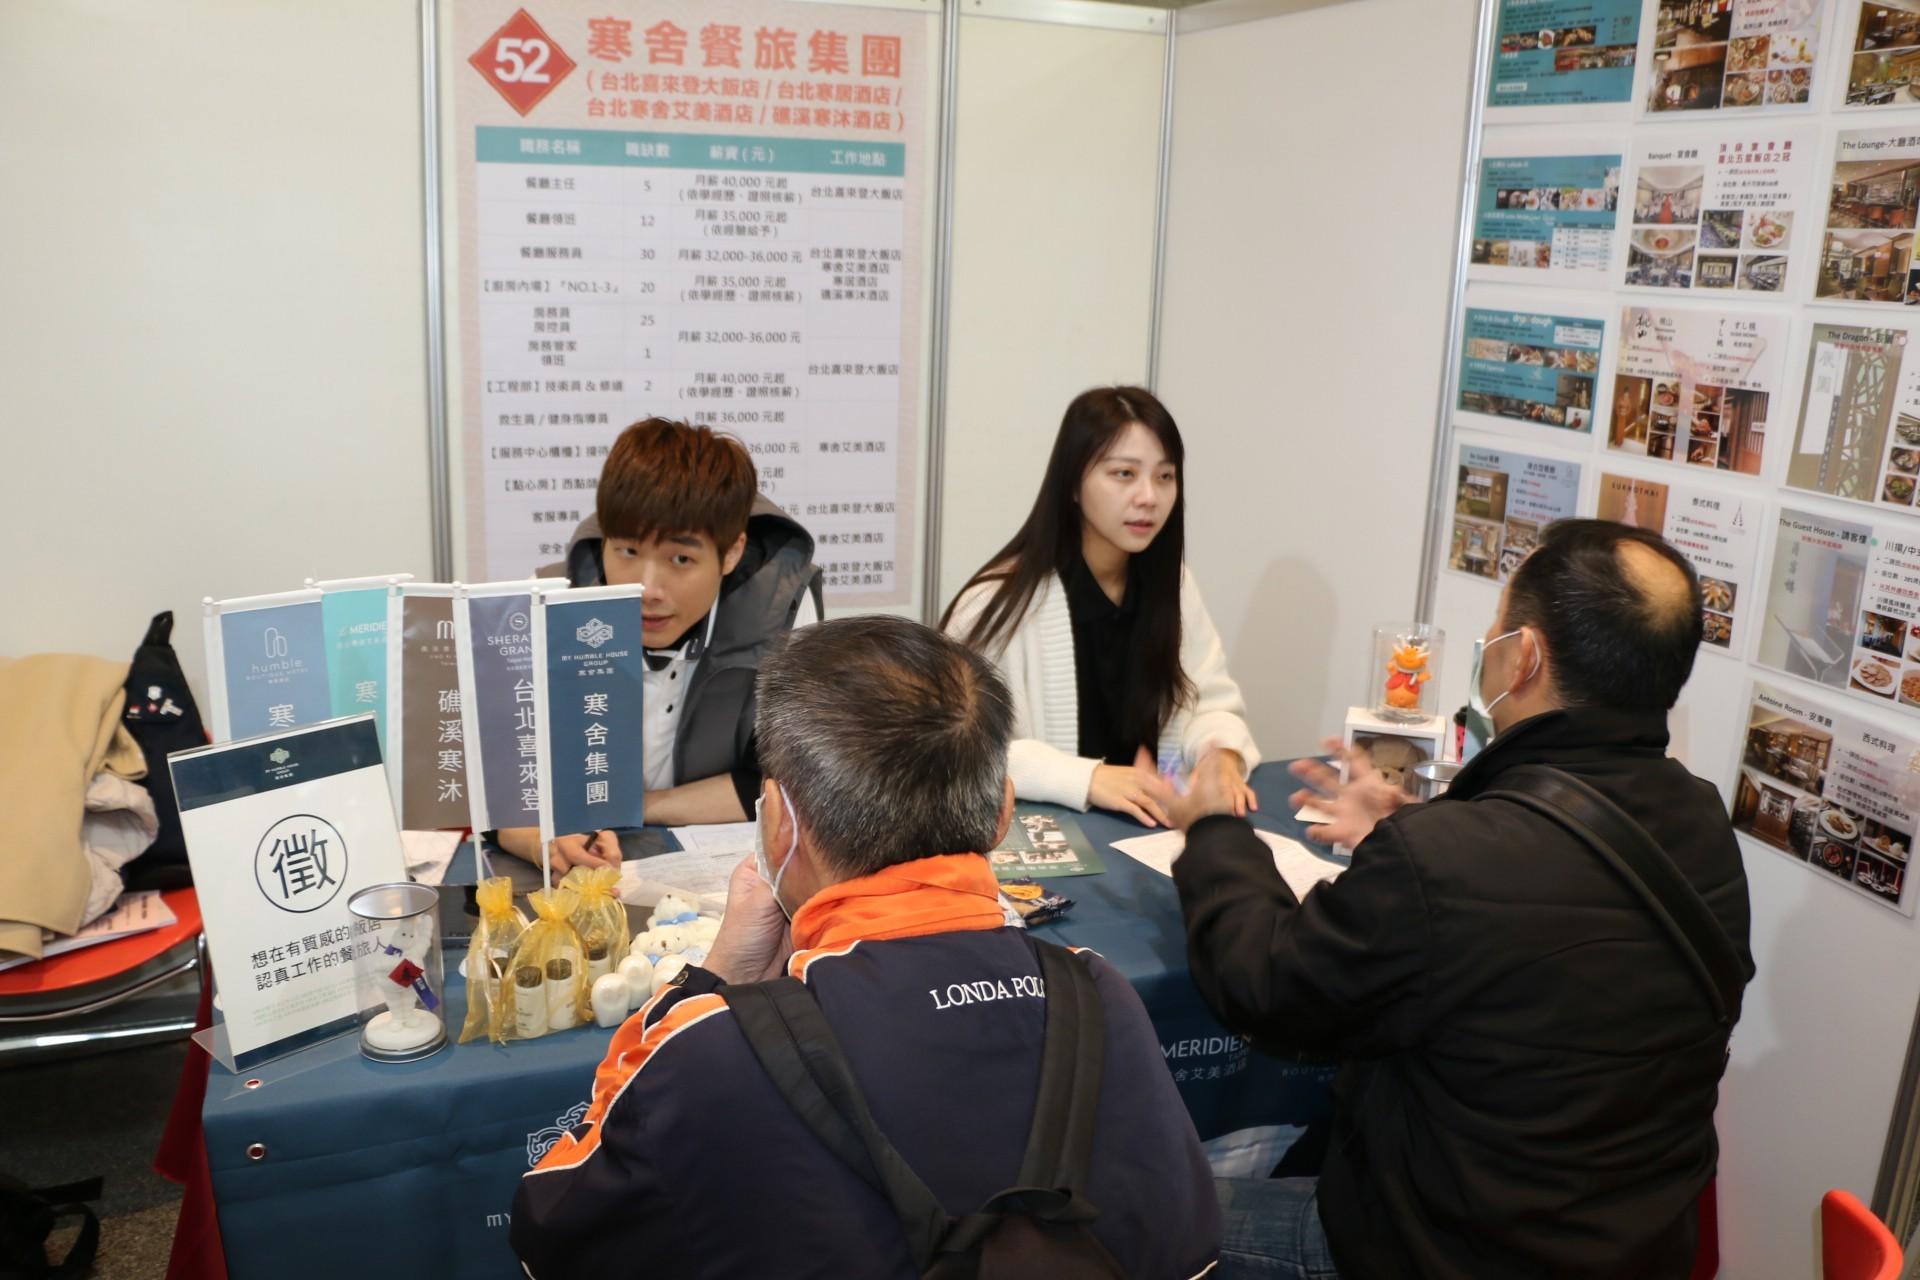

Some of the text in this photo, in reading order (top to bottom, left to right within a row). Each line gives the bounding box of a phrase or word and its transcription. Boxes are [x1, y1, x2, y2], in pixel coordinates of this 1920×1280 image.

[586, 16, 902, 78] 寒舍餐旅集團
[494, 37, 551, 84] 52
[1843, 141, 1856, 150] The
[830, 150, 887, 168] 工作地點
[1647, 152, 1672, 160] Banquet
[525, 176, 576, 191] 餐廳主任
[644, 180, 652, 192] 5
[695, 174, 788, 190] 月薪 40,000 元起
[811, 186, 903, 201] 台北喜來登大飯店
[525, 212, 577, 226] 餐廳領班
[640, 215, 655, 227] 12
[695, 209, 788, 224] 月薪 35,000 元起
[519, 246, 583, 260] 餐廳服務員
[640, 249, 656, 261] 30
[677, 248, 803, 264] 月薪 32,000-36,000 元
[810, 247, 902, 261] 台北喜來登大飯店
[822, 262, 890, 275] 寒舍艾美酒店
[640, 282, 656, 294] 20
[695, 274, 787, 289] 月薪 35,000 元起
[533, 306, 571, 319] 房務員
[640, 314, 656, 327] 25
[677, 330, 801, 345] 月薪 32,000-36,000 元
[1828, 331, 1840, 340] The
[1842, 332, 1869, 343] Dragon
[541, 354, 566, 367] 領班
[645, 347, 652, 360] 1
[808, 362, 899, 376] 台北喜來登大飯店
[644, 379, 652, 392] 2
[694, 373, 785, 387] 月薪 40,000 元起
[695, 410, 785, 425] 月薪 36,000 元起
[789, 441, 800, 455] 元
[819, 441, 886, 454] 寒舍艾美酒店
[761, 467, 785, 479] 元起
[807, 502, 895, 516] 台北喜來登大飯店
[532, 510, 581, 523] 客服專員
[1779, 518, 1791, 528] The
[1792, 521, 1813, 533] Guest
[1813, 526, 1836, 538] House
[818, 532, 884, 545] 寒舍艾美酒店
[350, 621, 388, 634] MERIDIE
[487, 633, 532, 647] SHERA
[605, 650, 629, 659] HOUSE
[251, 658, 303, 674] humble
[355, 680, 378, 704] 寒
[1758, 693, 1783, 709] Antoine
[1784, 702, 1804, 718] Room
[268, 704, 296, 728] 寒
[438, 689, 464, 803] 礁溪寒沐
[513, 678, 540, 812] 台北喜來登
[583, 692, 609, 806] 寒舍集團
[1862, 732, 1897, 754] 西式料理
[269, 829, 337, 900] 徵
[250, 918, 382, 970] 想在有質感的飯店
[255, 934, 388, 992] 認真工作的餐旅人
[929, 980, 1013, 1010] LONDA
